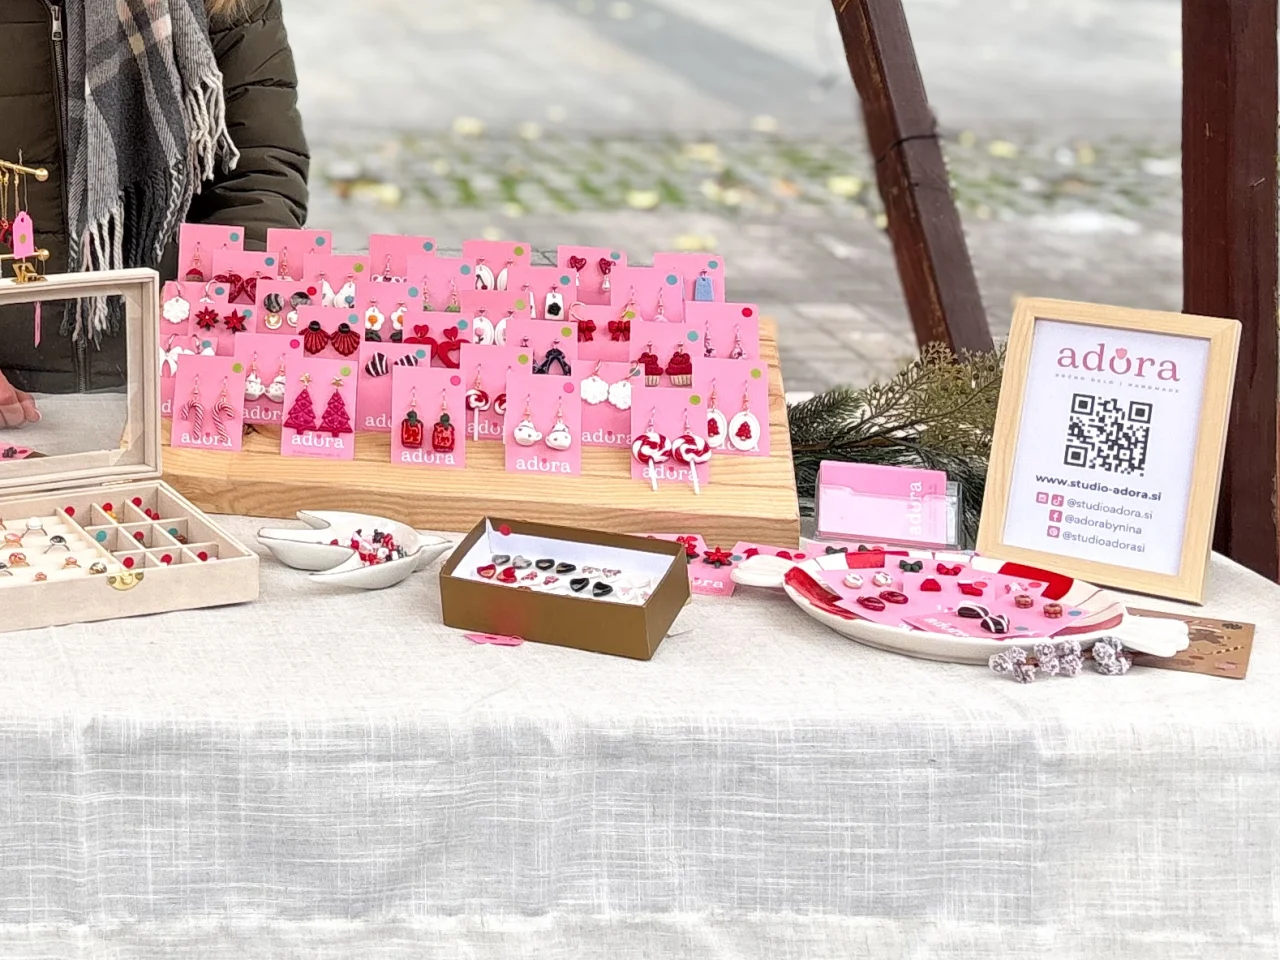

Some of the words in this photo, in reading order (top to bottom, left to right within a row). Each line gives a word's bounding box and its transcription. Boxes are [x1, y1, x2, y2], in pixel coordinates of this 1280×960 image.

[1057, 343, 1180, 381] adora
[243, 405, 283, 421] ador
[292, 431, 344, 449] adora
[401, 448, 456, 465] adora
[516, 456, 571, 473] adora
[1035, 474, 1162, 501] www.studio-adora.si
[1067, 498, 1153, 520] @studioadora.si
[1064, 514, 1142, 534] @adorabynina
[1062, 531, 1146, 553] @studioadorasi
